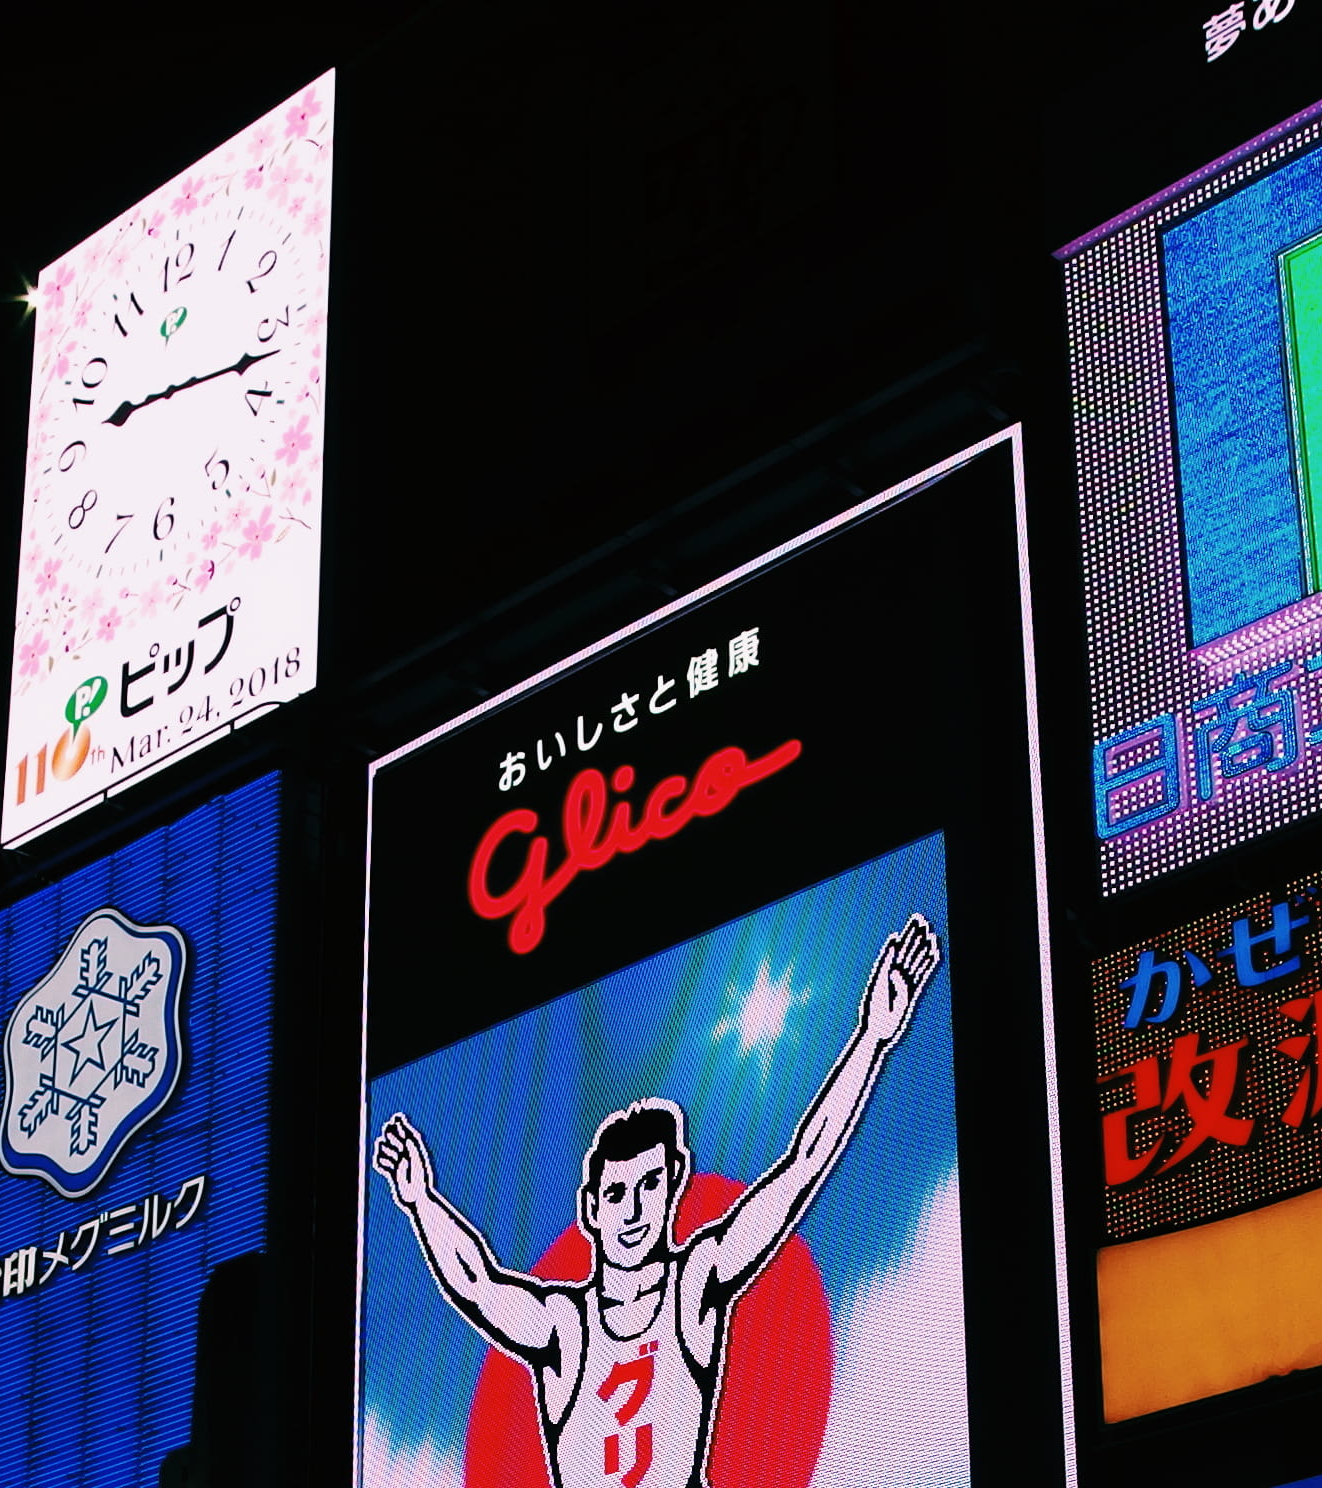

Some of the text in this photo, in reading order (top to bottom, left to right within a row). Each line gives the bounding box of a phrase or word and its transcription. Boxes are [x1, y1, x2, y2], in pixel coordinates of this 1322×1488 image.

[110, 725, 171, 774] Mar.
[229, 646, 301, 708] 2018
[120, 596, 241, 718] ピップ
[498, 627, 760, 791] おいしさと健康
